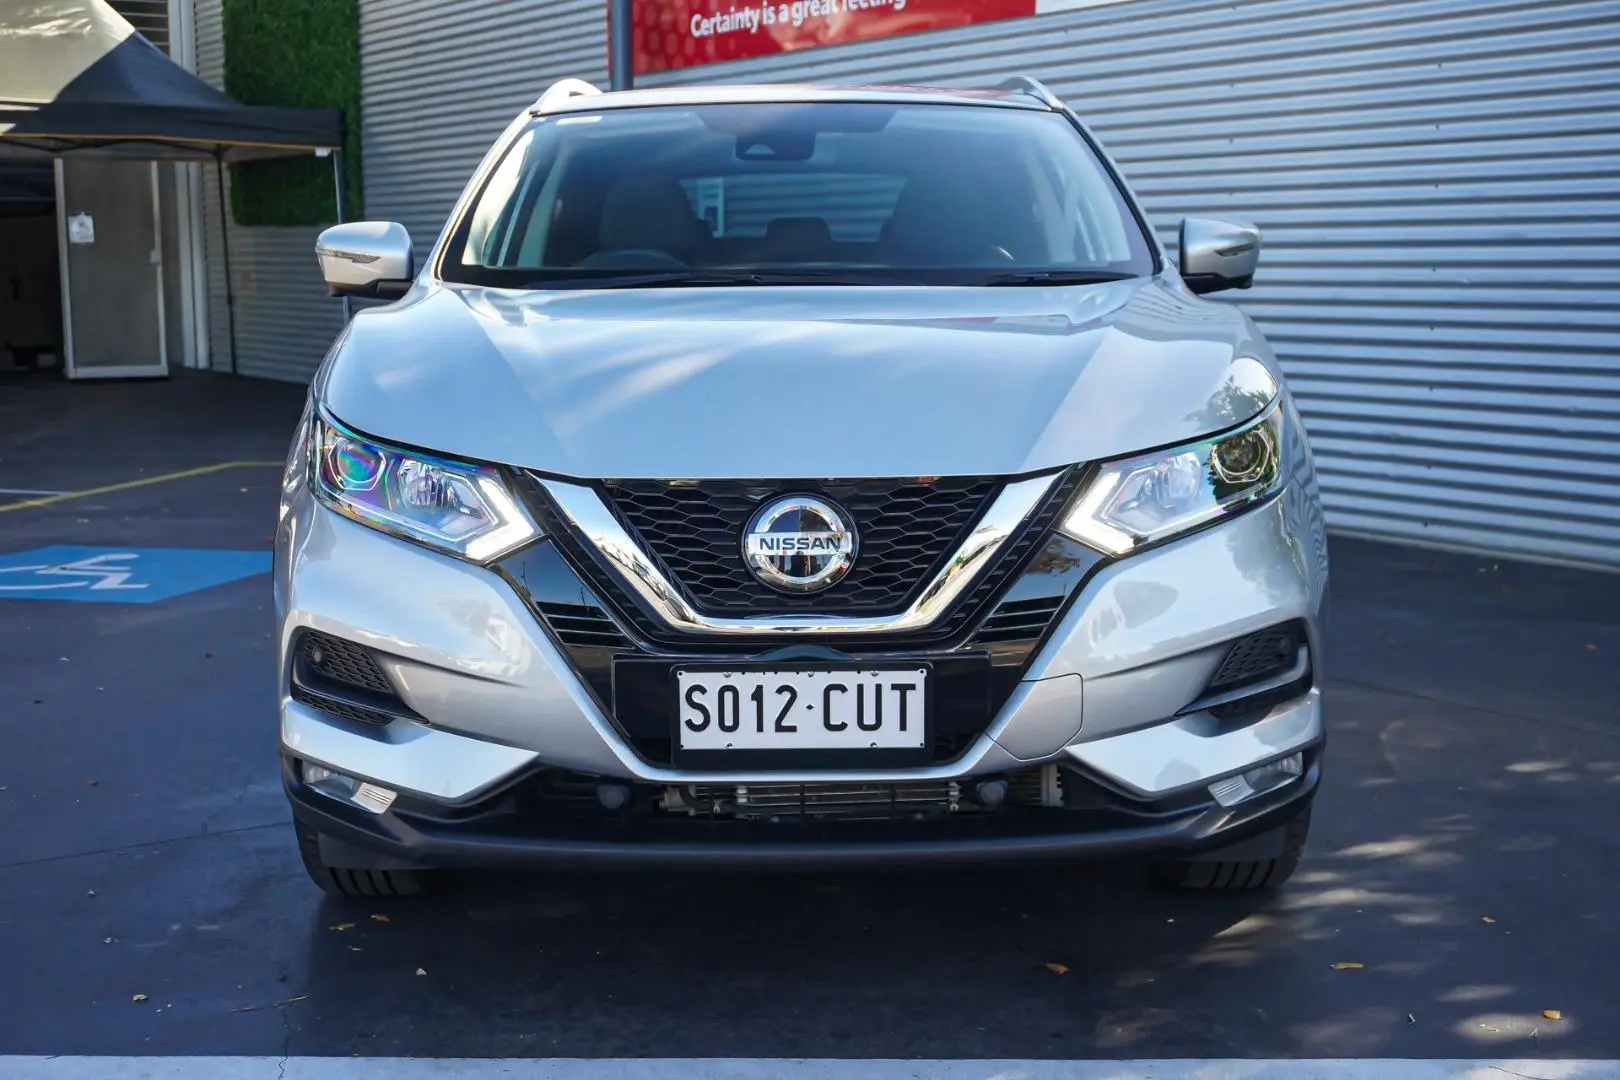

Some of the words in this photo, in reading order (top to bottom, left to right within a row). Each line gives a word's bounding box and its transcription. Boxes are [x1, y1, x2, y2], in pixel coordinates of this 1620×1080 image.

[690, 6, 760, 38] Certainty
[762, 0, 777, 25] is
[779, 3, 790, 24] a
[759, 537, 841, 550] NISSAN
